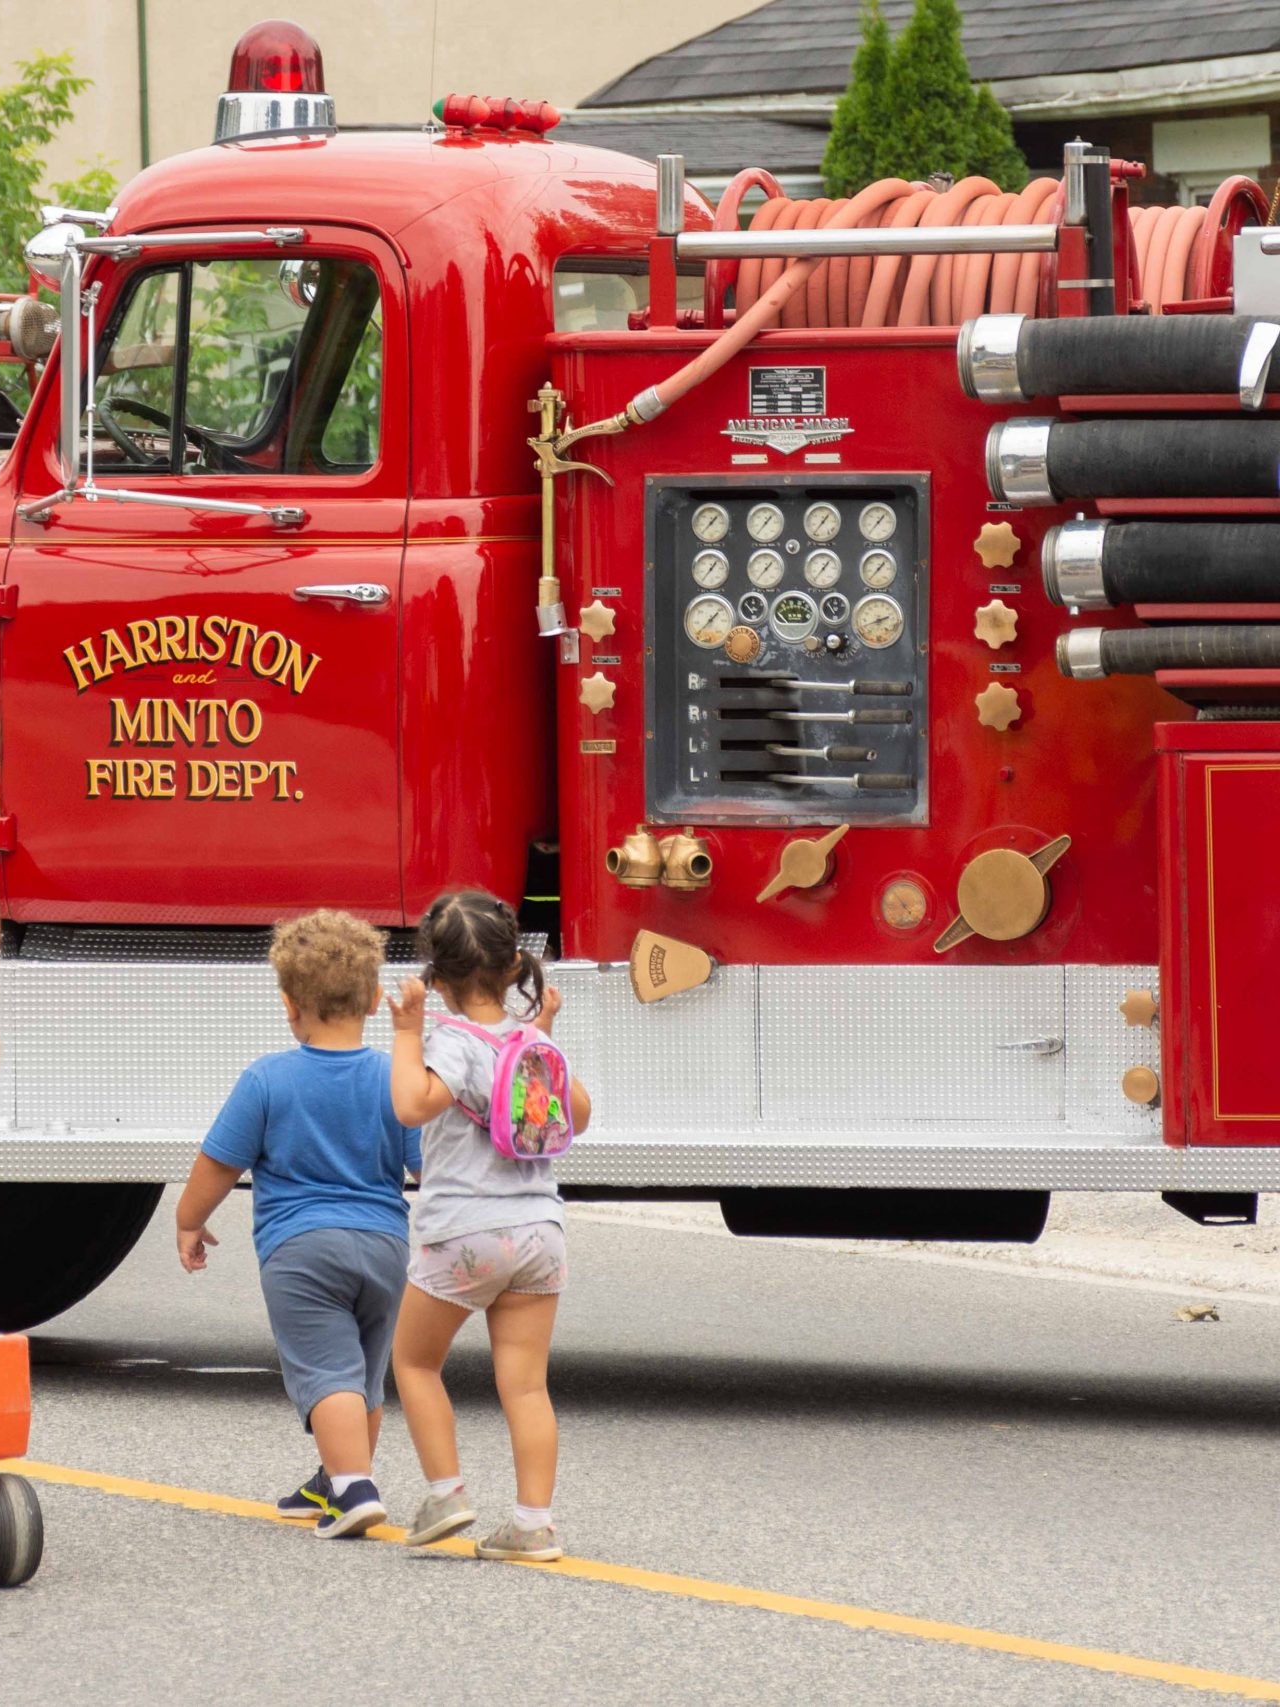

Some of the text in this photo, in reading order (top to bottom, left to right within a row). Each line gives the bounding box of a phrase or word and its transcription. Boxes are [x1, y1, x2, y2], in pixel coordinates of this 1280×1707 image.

[63, 615, 322, 695] HARRISTON
[172, 669, 218, 685] and
[109, 698, 262, 747] MINTO
[86, 759, 304, 801] FIRE DEPT.
